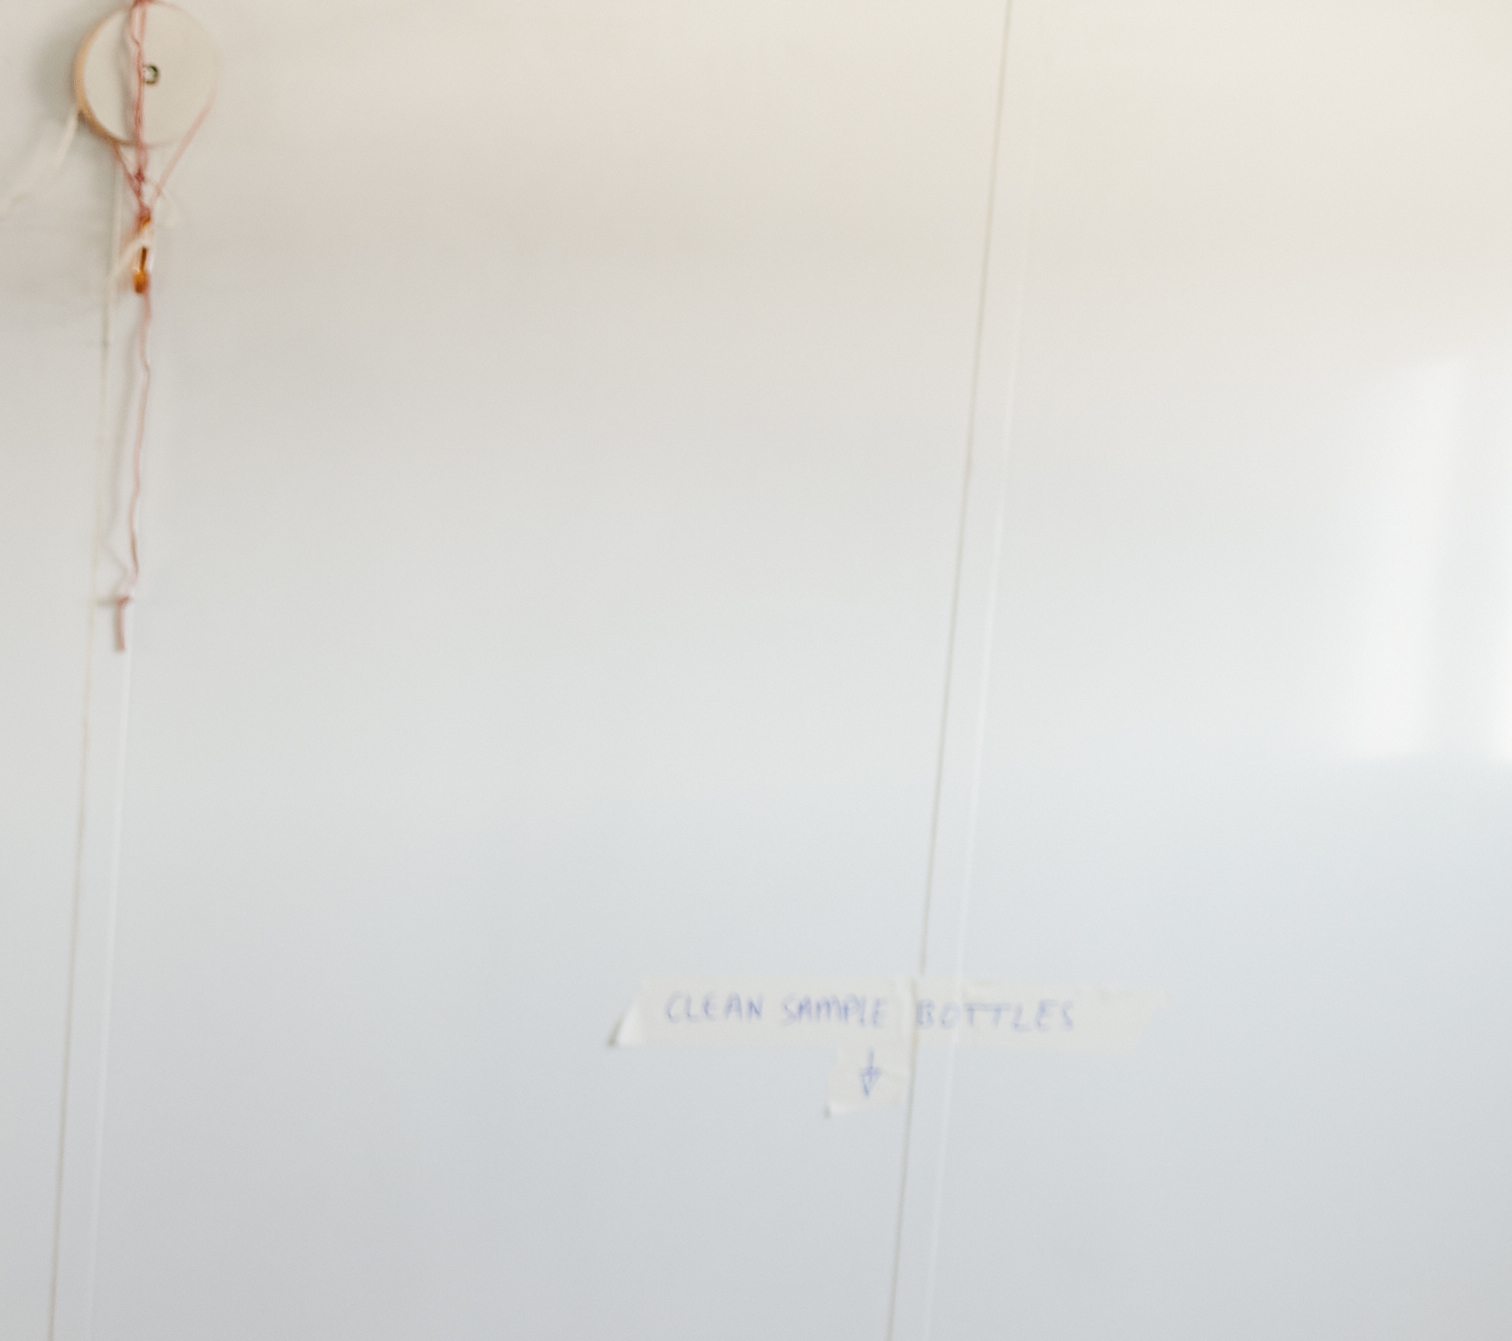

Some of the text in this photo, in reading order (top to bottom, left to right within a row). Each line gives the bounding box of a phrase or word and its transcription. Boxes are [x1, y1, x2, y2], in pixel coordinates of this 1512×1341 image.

[665, 990, 1076, 1032] CLEAN SAMPLE BOTTLES
